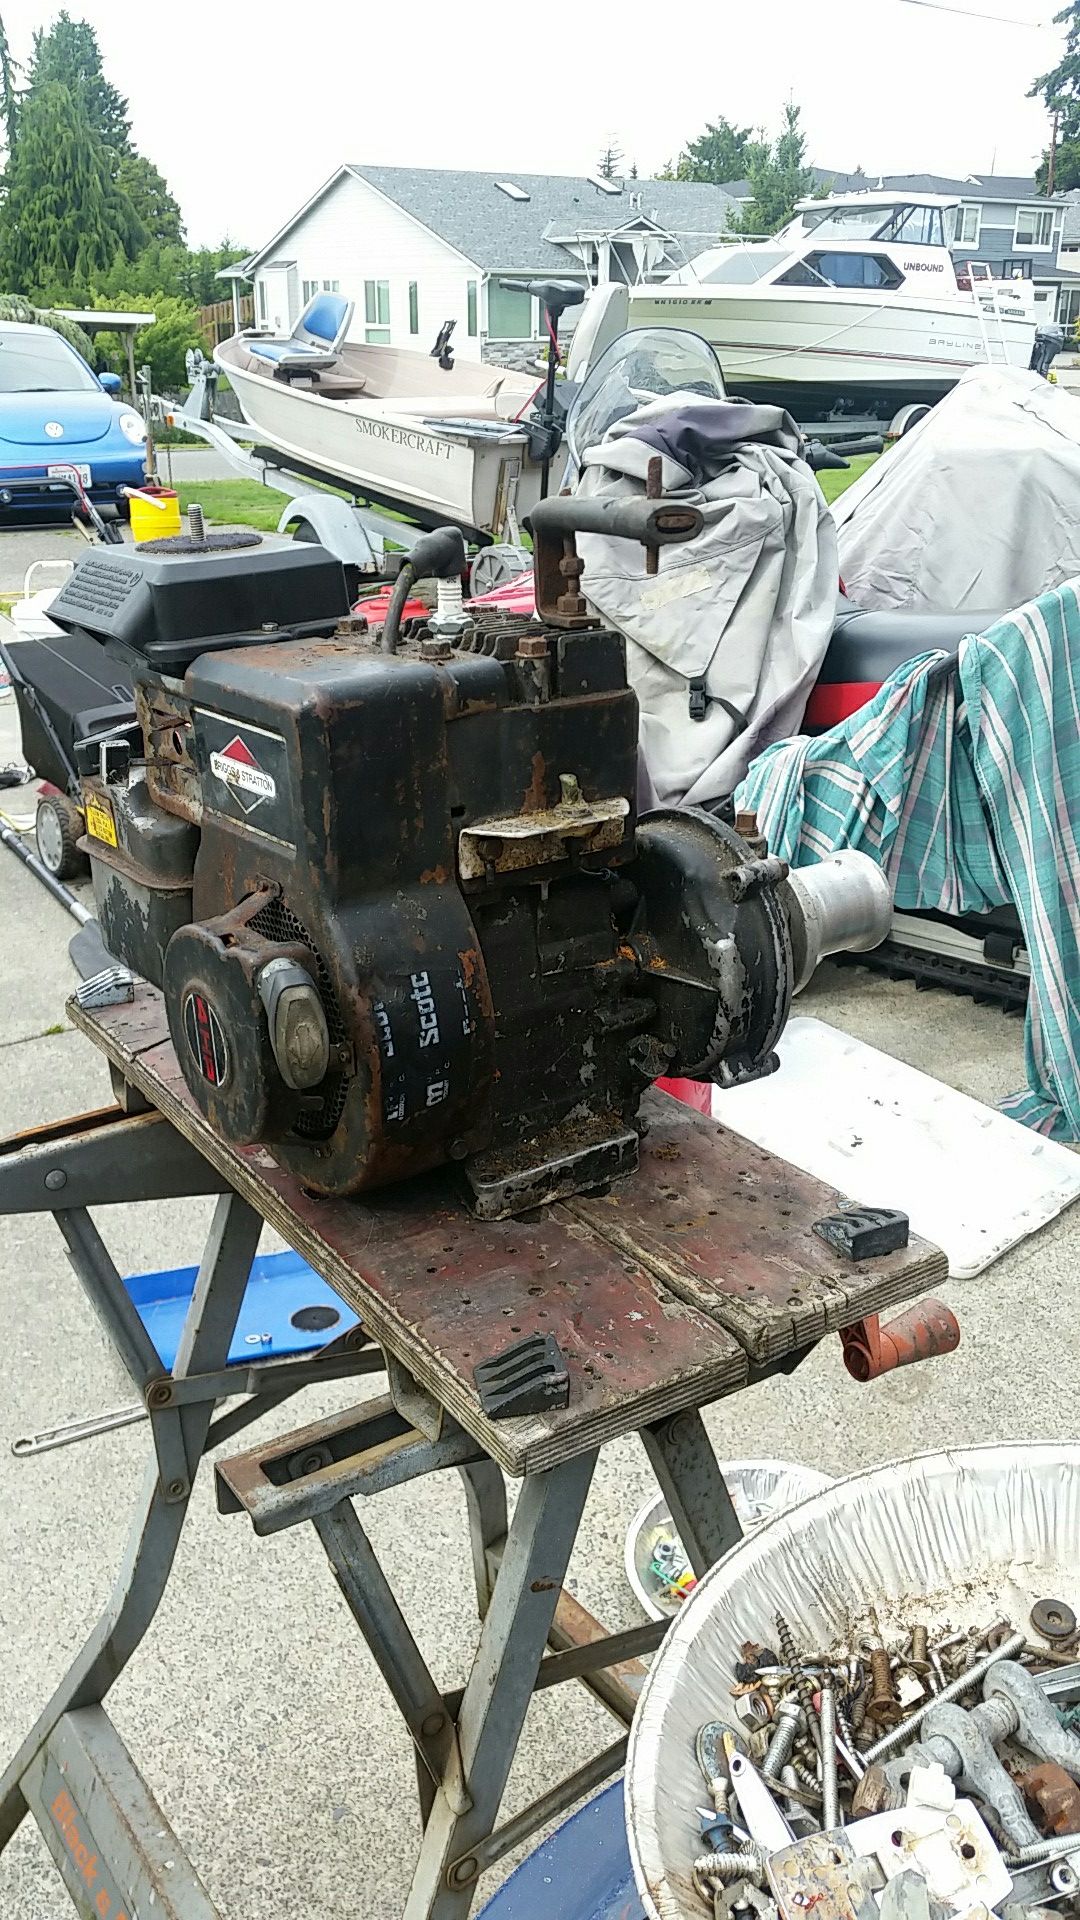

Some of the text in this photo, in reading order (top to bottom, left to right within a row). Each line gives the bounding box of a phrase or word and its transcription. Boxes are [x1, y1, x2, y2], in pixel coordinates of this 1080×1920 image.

[904, 262, 944, 272] UNBOUND
[928, 338, 986, 350] BAYLINE
[355, 418, 454, 459] SMOKERCRAFT
[241, 770, 273, 792] STRATTON
[52, 1790, 97, 1888] Black
